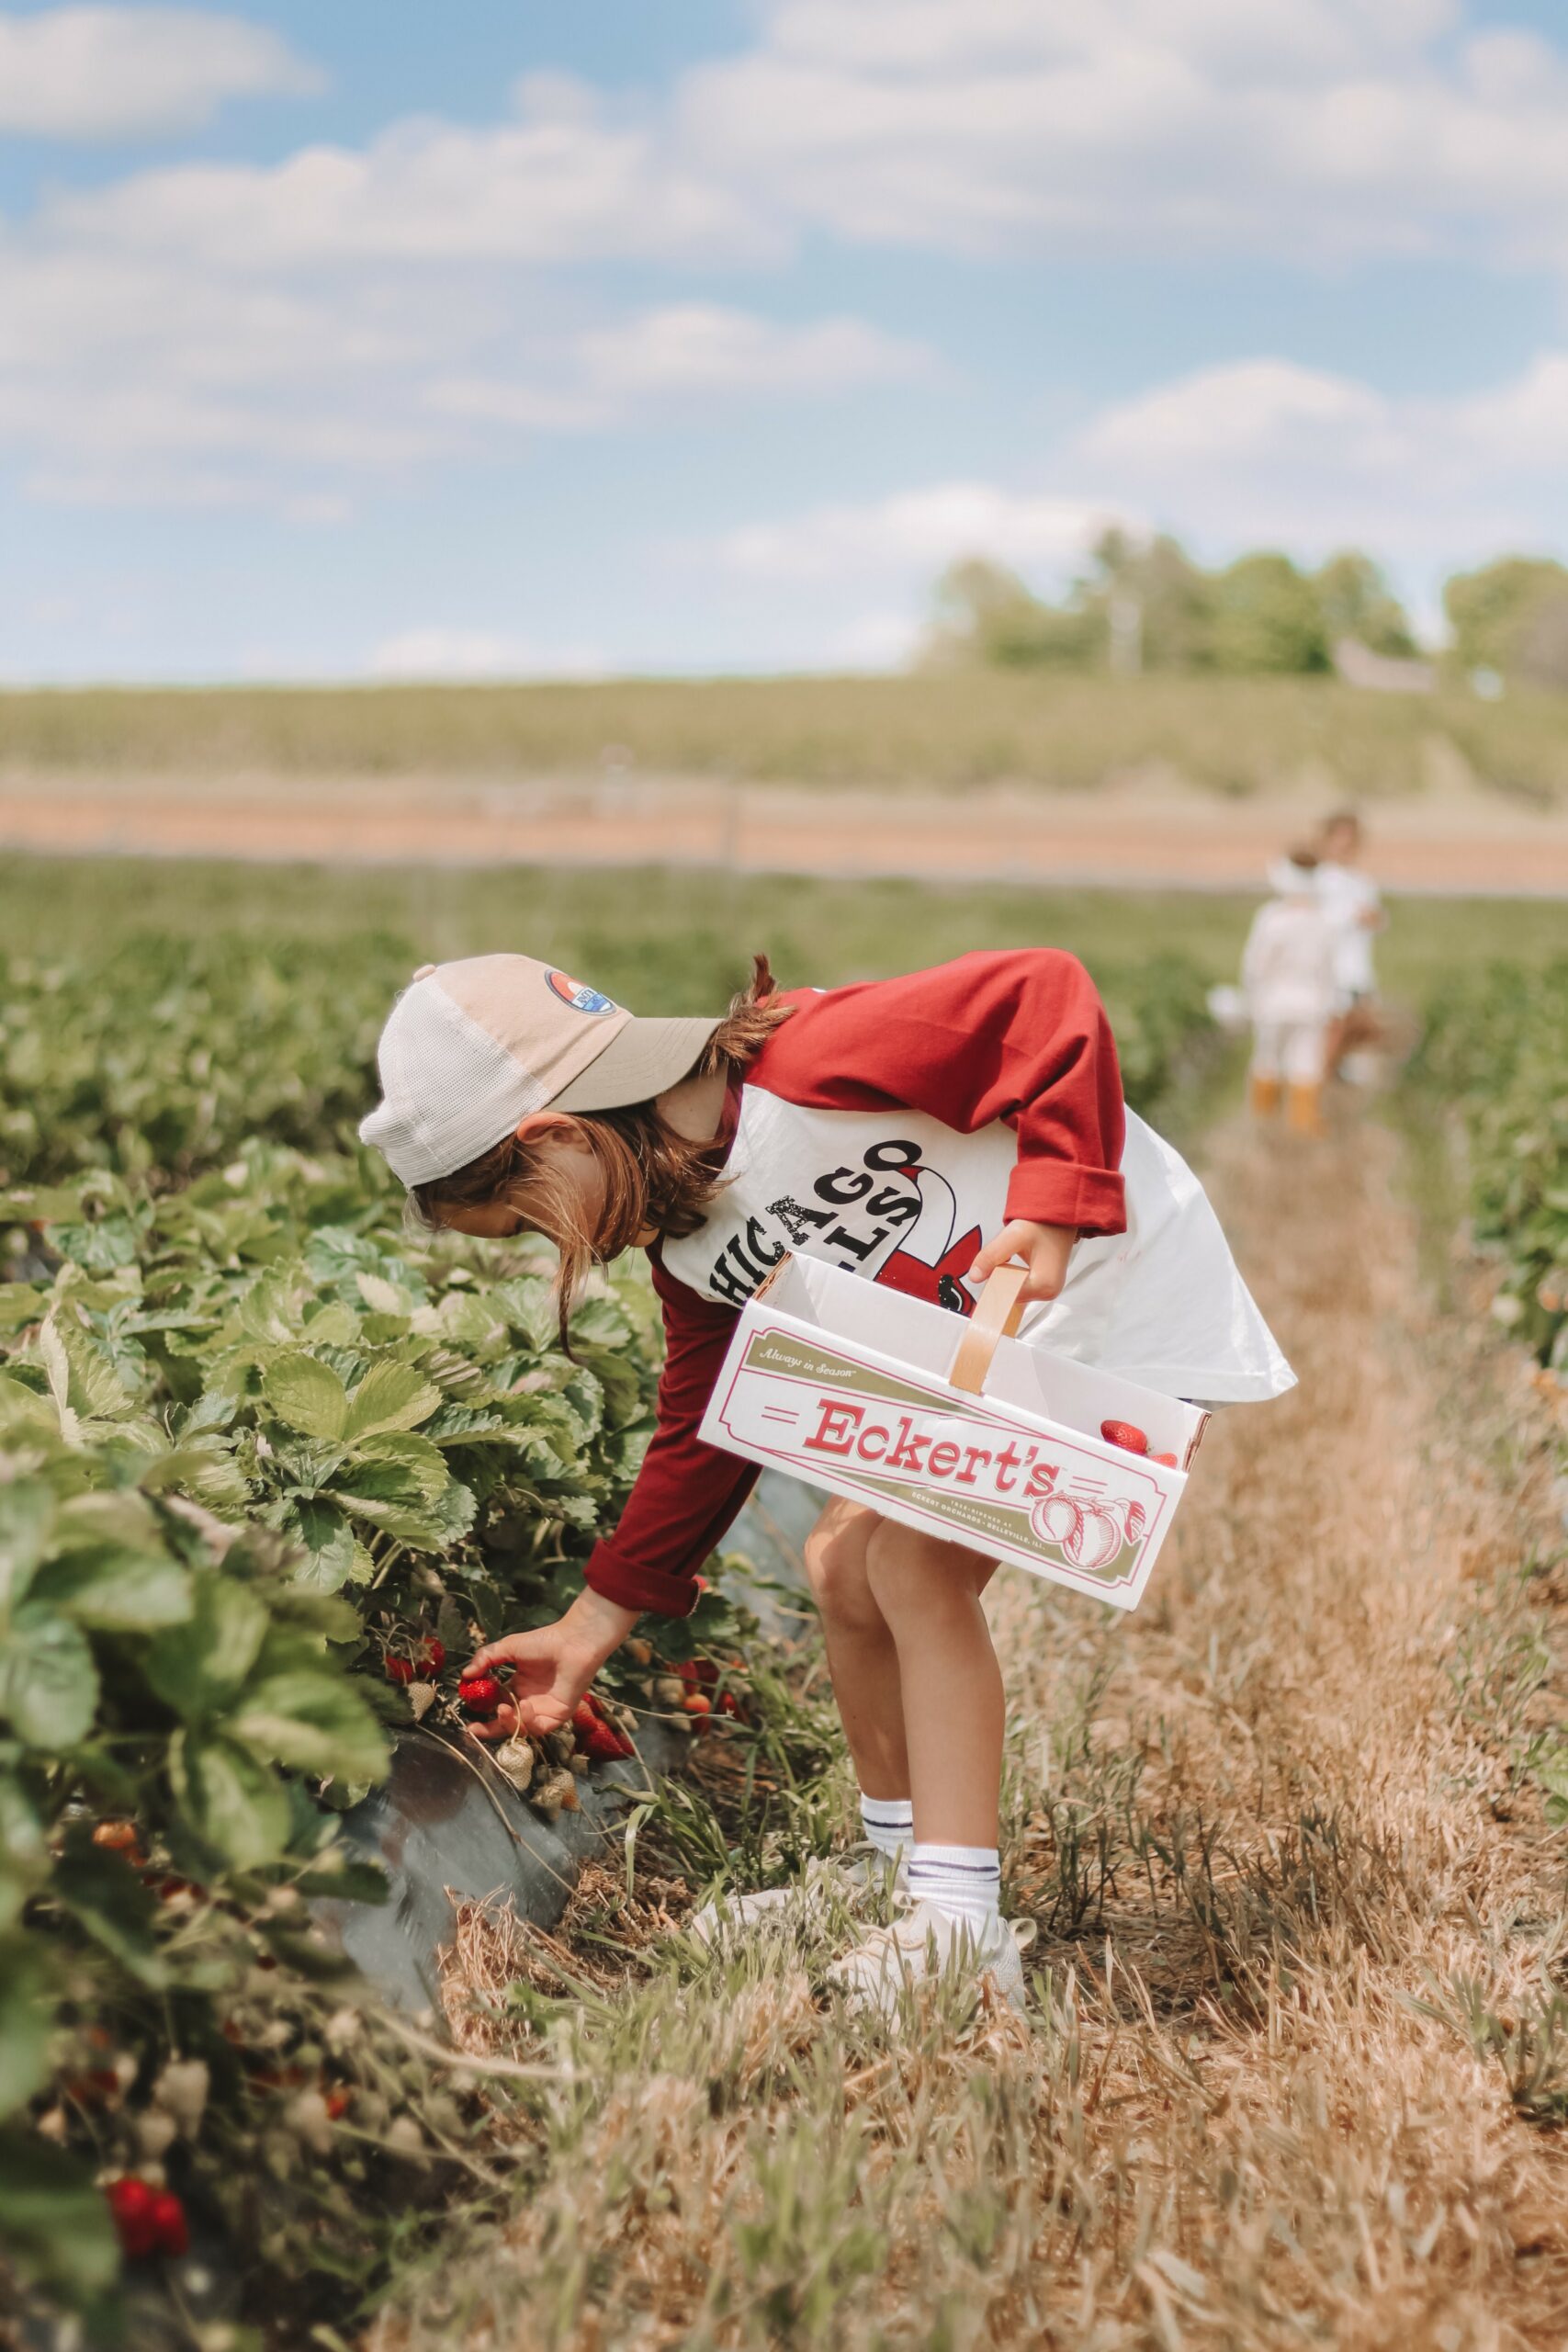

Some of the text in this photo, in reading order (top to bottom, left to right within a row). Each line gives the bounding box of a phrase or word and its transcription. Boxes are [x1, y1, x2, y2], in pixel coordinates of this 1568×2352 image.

[709, 1140, 922, 1306] HICAGO
[760, 1348, 803, 1368] Always
[803, 1360, 814, 1371] in
[803, 1397, 1061, 1499] Eckert's
[911, 1491, 940, 1508] ECKERT
[941, 1504, 981, 1524] ORCHARDS
